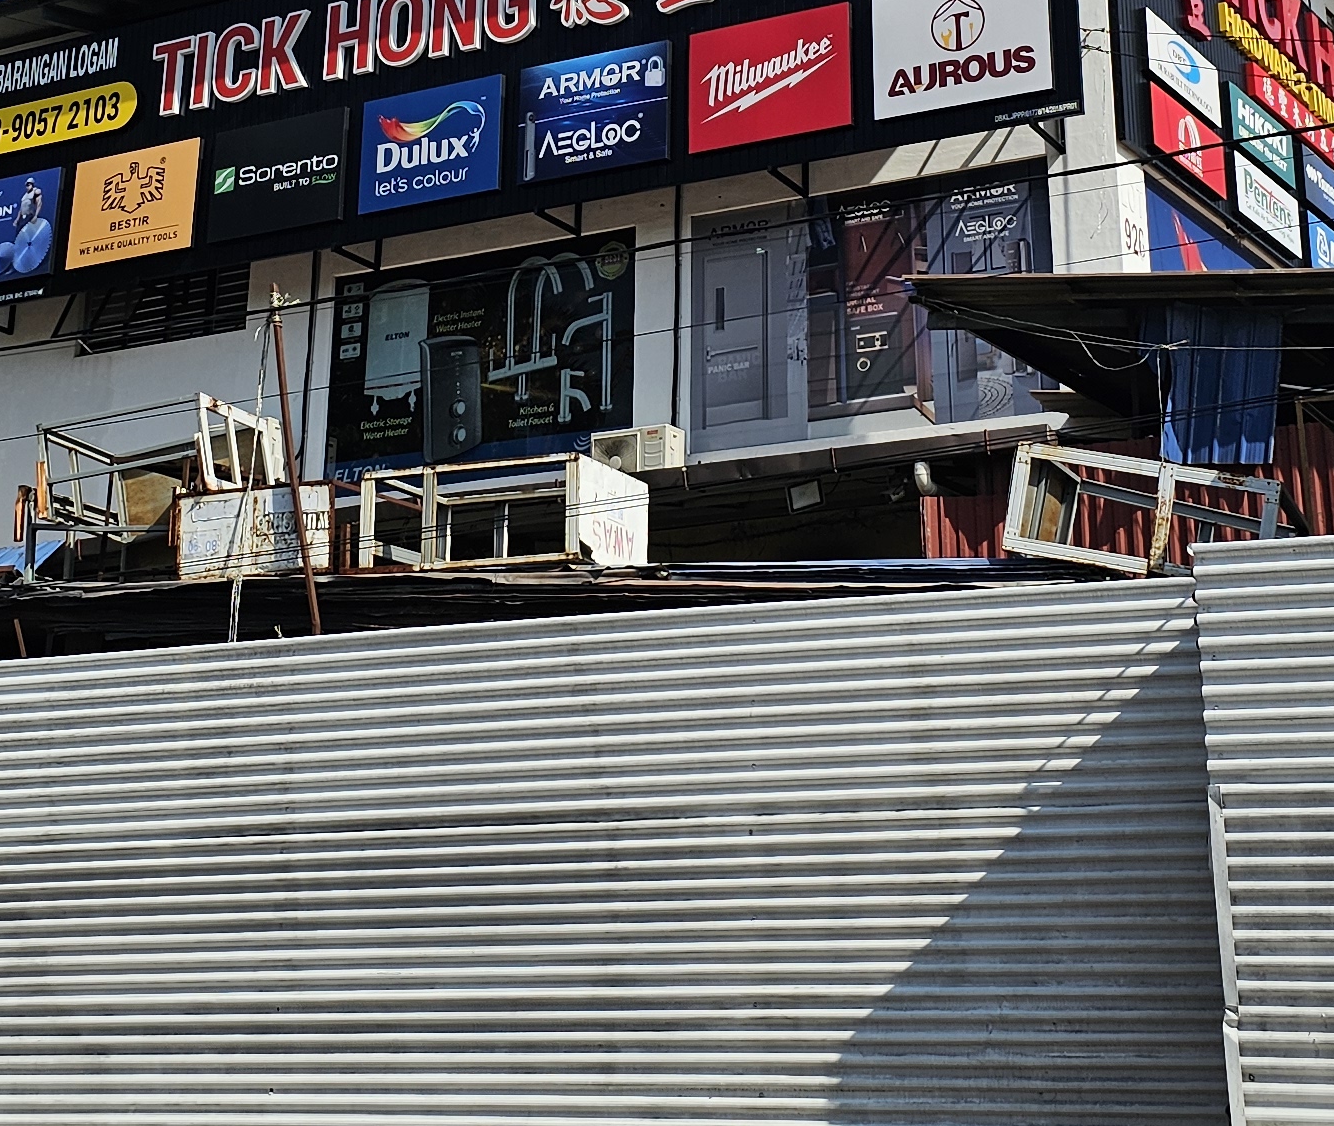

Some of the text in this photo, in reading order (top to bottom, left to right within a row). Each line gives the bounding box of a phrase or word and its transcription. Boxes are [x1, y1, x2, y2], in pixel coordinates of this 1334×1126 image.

[1218, 2, 1300, 91] HARDWARE
[69, 37, 119, 78] LOGAM
[153, 9, 311, 116] TICK
[538, 61, 641, 100] ARMOR
[700, 35, 833, 107] Milwaukee
[888, 45, 1036, 98] AUROUS
[66, 91, 121, 131] 2103
[376, 133, 469, 174] Dulux
[565, 153, 587, 164] Smart
[595, 148, 613, 158] Safe
[238, 154, 339, 186] Sorento
[273, 179, 296, 191] BUILT
[299, 177, 310, 186] TO
[375, 166, 469, 197] let's colour
[983, 194, 1019, 205] PROTECTION
[1243, 167, 1294, 227] Pentens
[109, 215, 150, 232] BESTIR
[79, 230, 178, 256] WE MAKE QUALITY TOOLS
[433, 308, 485, 324] Electric Instant
[867, 303, 883, 312] BOX
[385, 331, 410, 342] ELTON
[436, 319, 482, 333] Water Heater
[519, 402, 554, 416] Kitchen &
[360, 415, 412, 430] Electric Storage
[508, 415, 553, 429] Toilet Faucet
[363, 427, 408, 441] Water Heater
